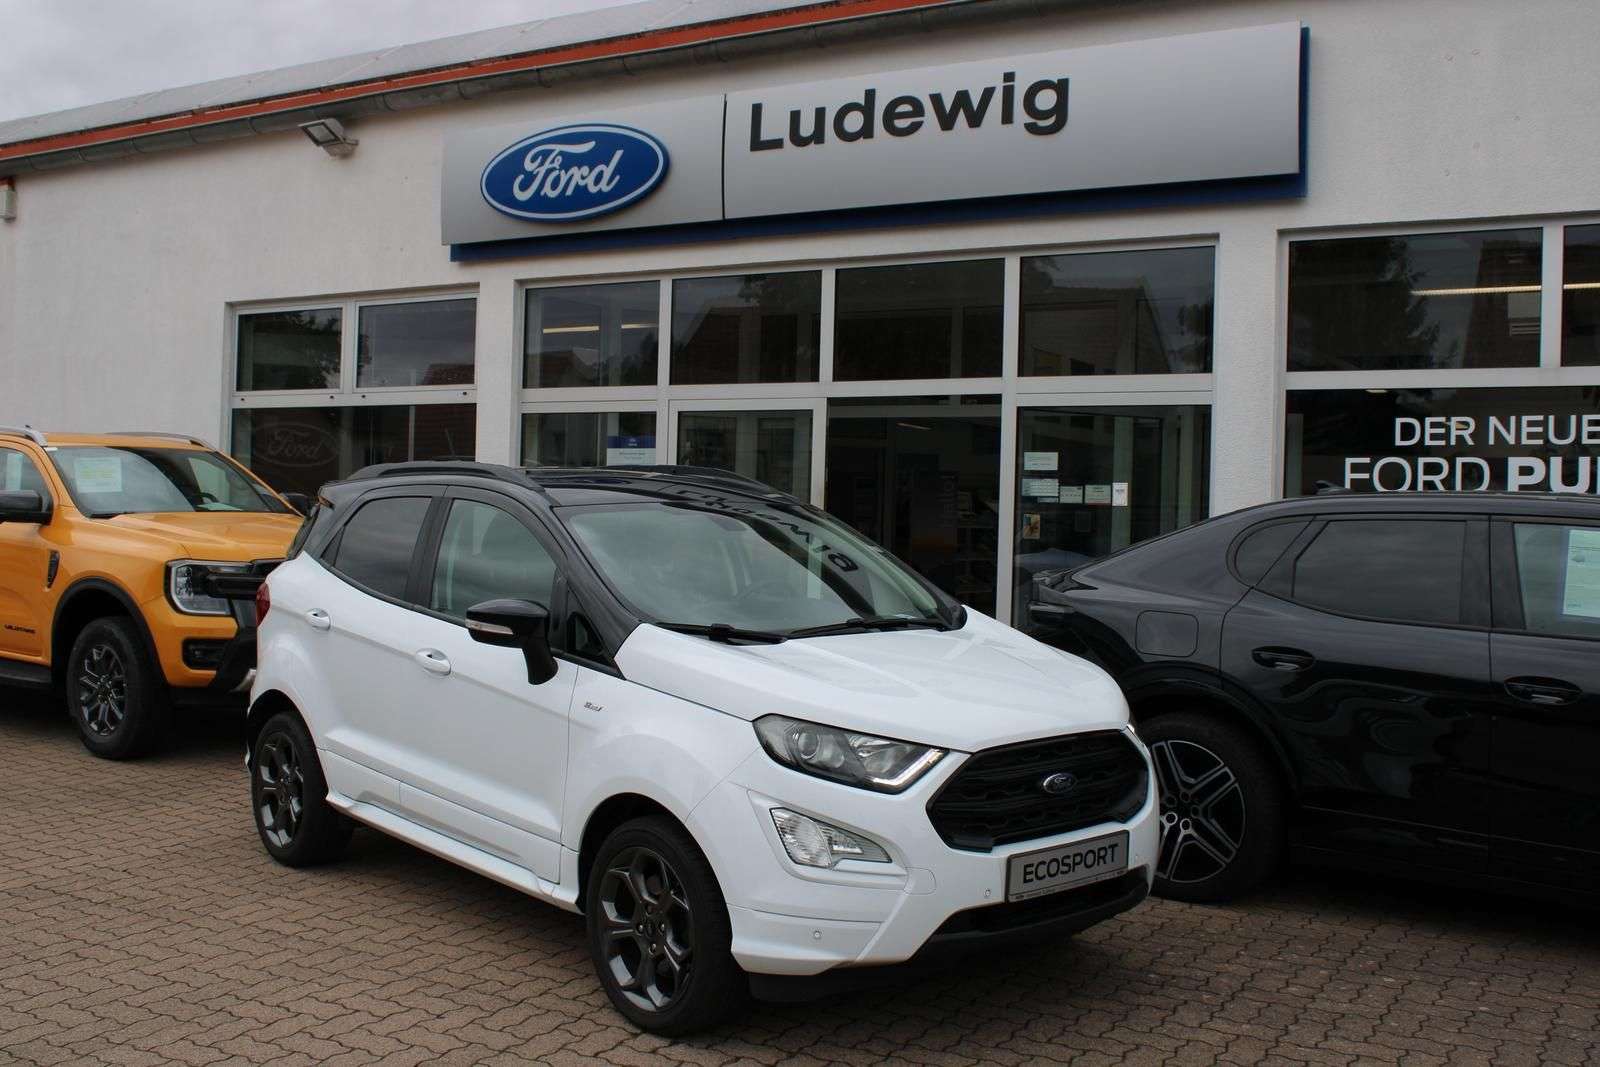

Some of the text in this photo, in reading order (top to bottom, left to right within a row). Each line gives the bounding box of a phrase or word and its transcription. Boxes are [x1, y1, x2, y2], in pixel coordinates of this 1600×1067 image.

[749, 71, 1069, 151] Ludewig
[512, 141, 624, 201] Ford
[1394, 414, 1600, 447] DER NEUE
[1344, 456, 1600, 495] FORD PU
[1022, 843, 1119, 884] ECOSPORT
